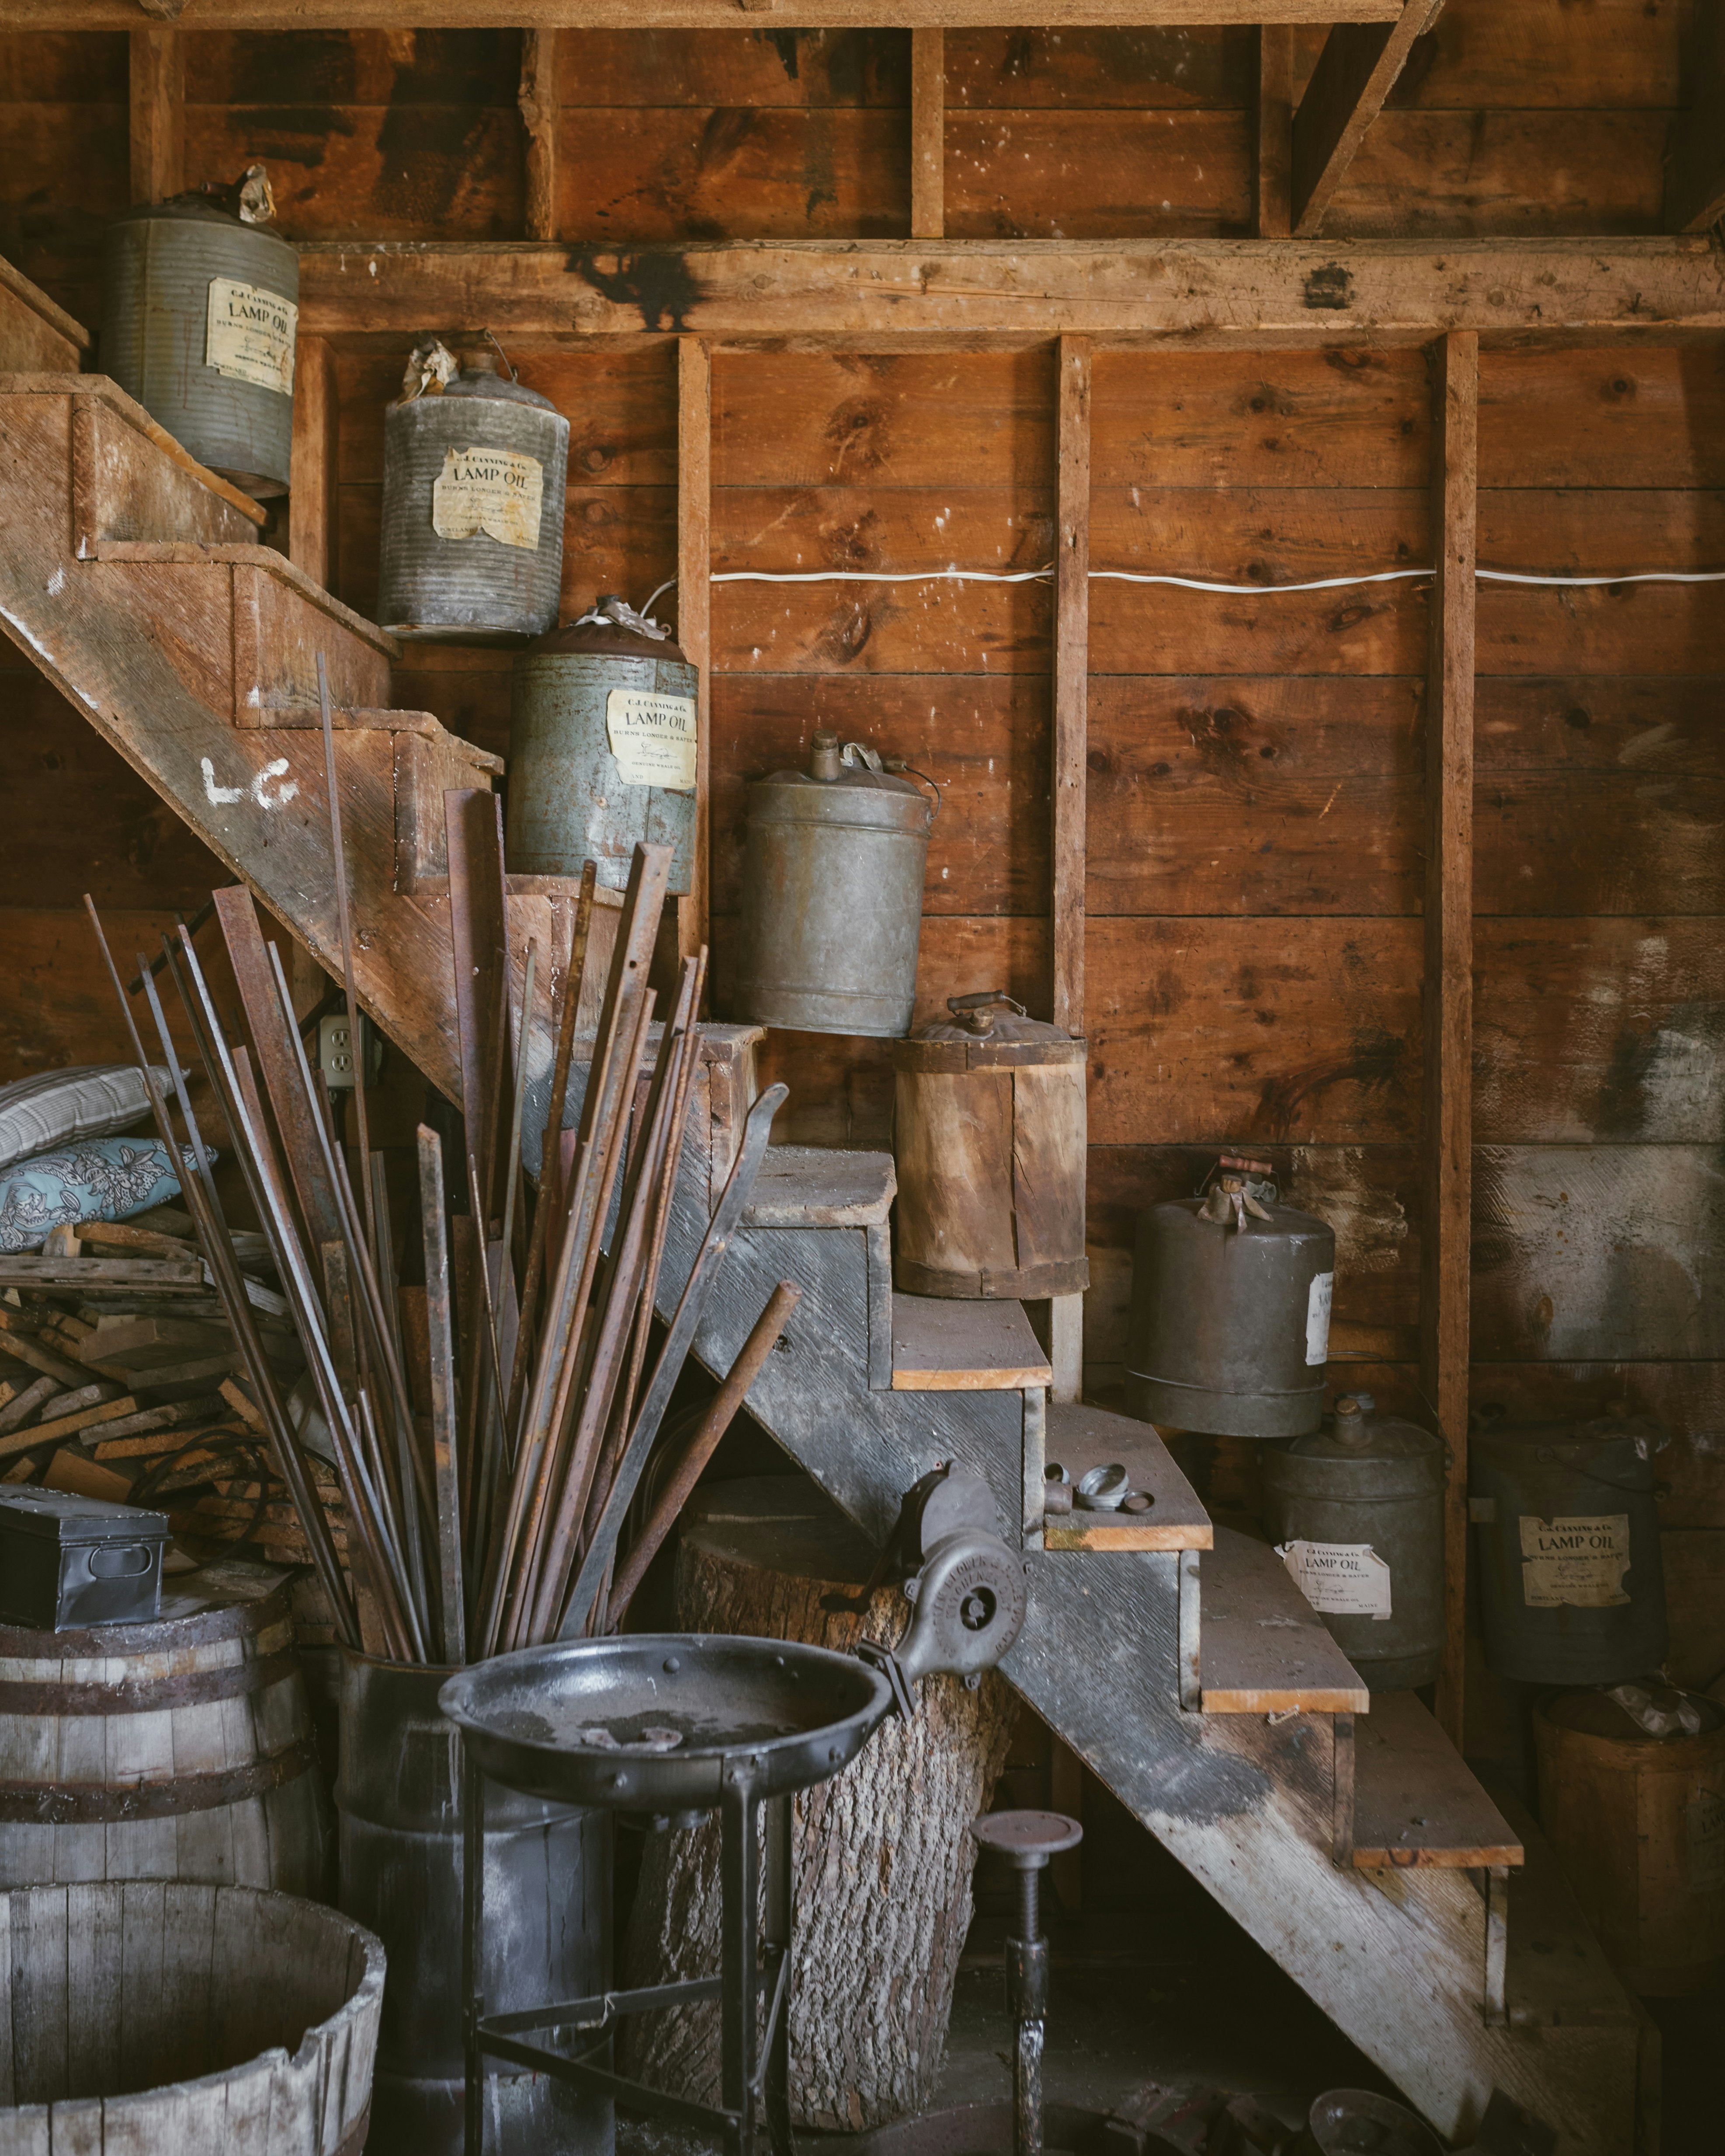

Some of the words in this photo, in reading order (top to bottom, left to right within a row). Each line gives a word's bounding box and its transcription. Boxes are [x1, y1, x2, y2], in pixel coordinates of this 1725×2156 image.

[229, 302, 270, 322] LAMP
[273, 315, 288, 335] OIL
[216, 319, 243, 329] BURNS
[246, 326, 272, 338] LONGER
[472, 456, 508, 466] CANNING
[454, 467, 499, 481] LAMP
[504, 471, 528, 490] OIL
[472, 486, 501, 495] LONGER
[512, 492, 536, 501] SAFER
[628, 699, 642, 707] C.J.
[643, 700, 673, 710] CANNING
[625, 712, 666, 726] LAMP
[669, 715, 687, 732] OIL
[1538, 1536, 1585, 1551] LAMP
[1589, 1535, 1614, 1549] OIL
[1305, 1559, 1337, 1568] LAMP
[1340, 1560, 1361, 1571] OIL
